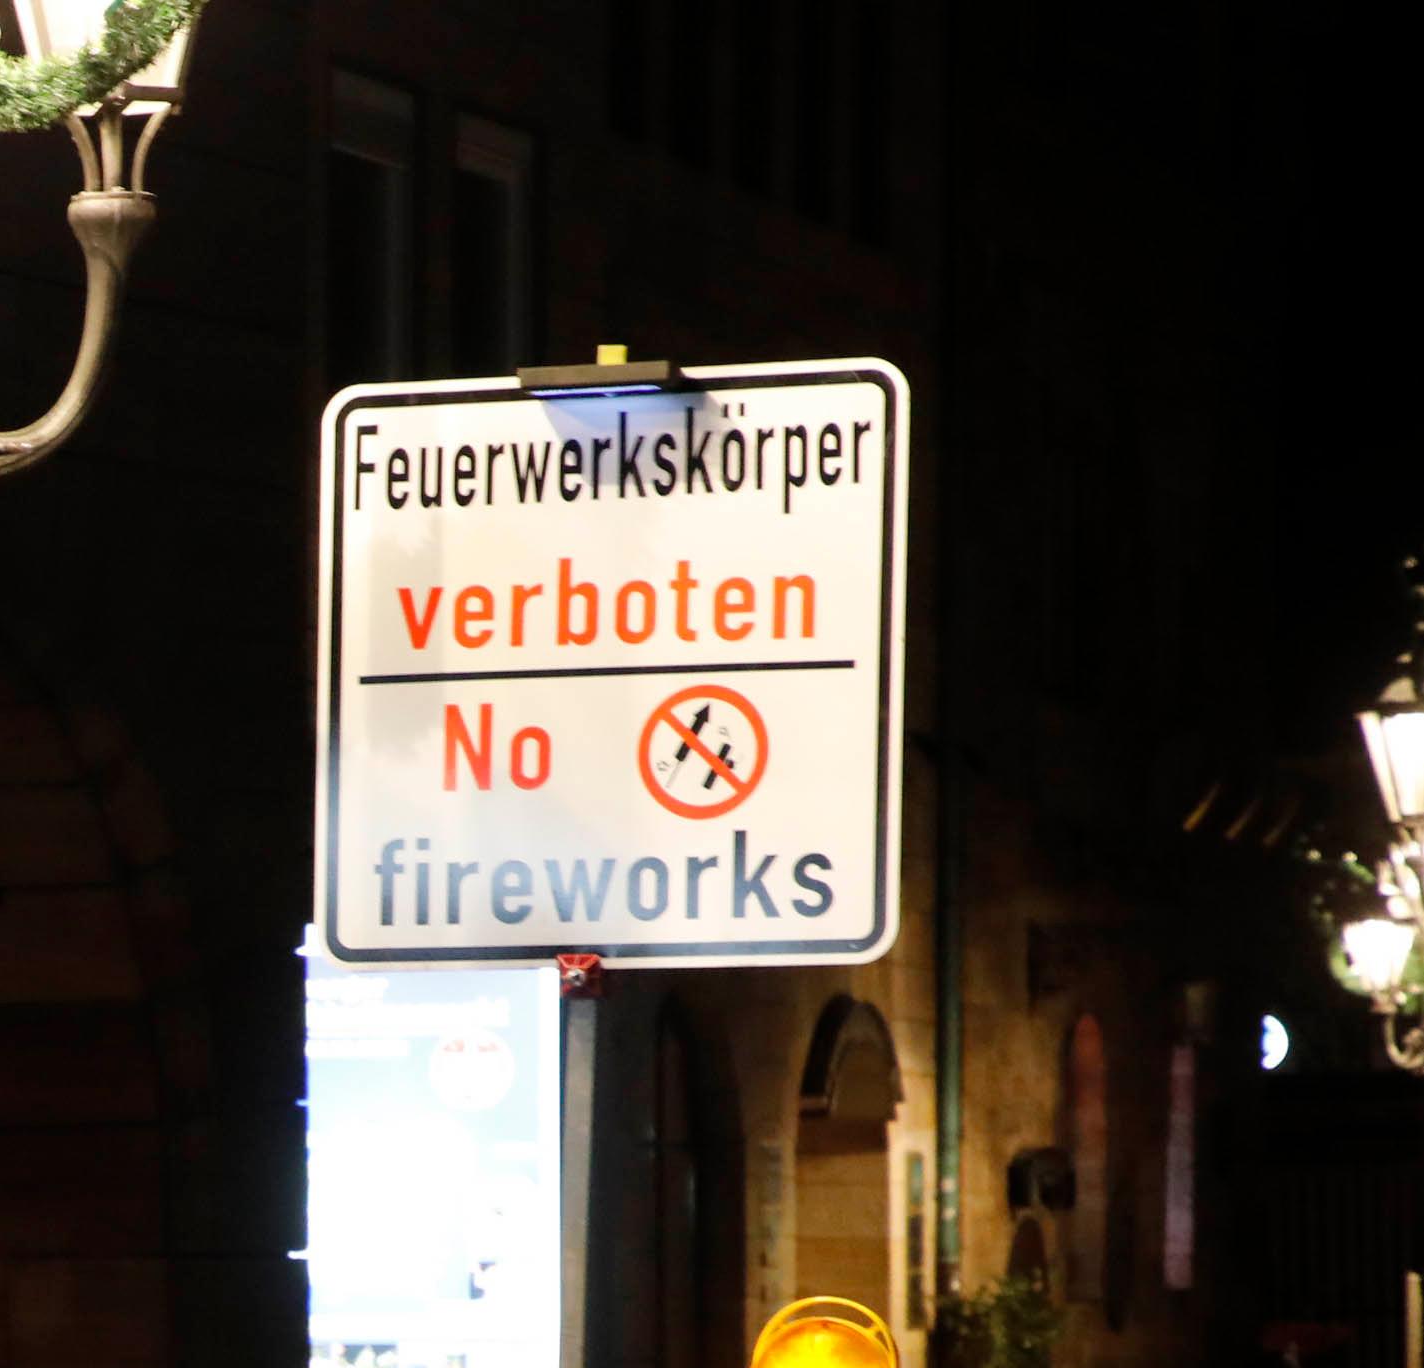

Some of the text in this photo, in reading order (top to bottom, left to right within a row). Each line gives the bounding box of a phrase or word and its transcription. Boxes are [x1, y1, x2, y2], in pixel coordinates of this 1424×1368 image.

[353, 402, 873, 514] Feuerwerkskörper
[397, 557, 817, 650] verboten
[442, 702, 552, 792] No
[373, 830, 835, 926] fireworks
